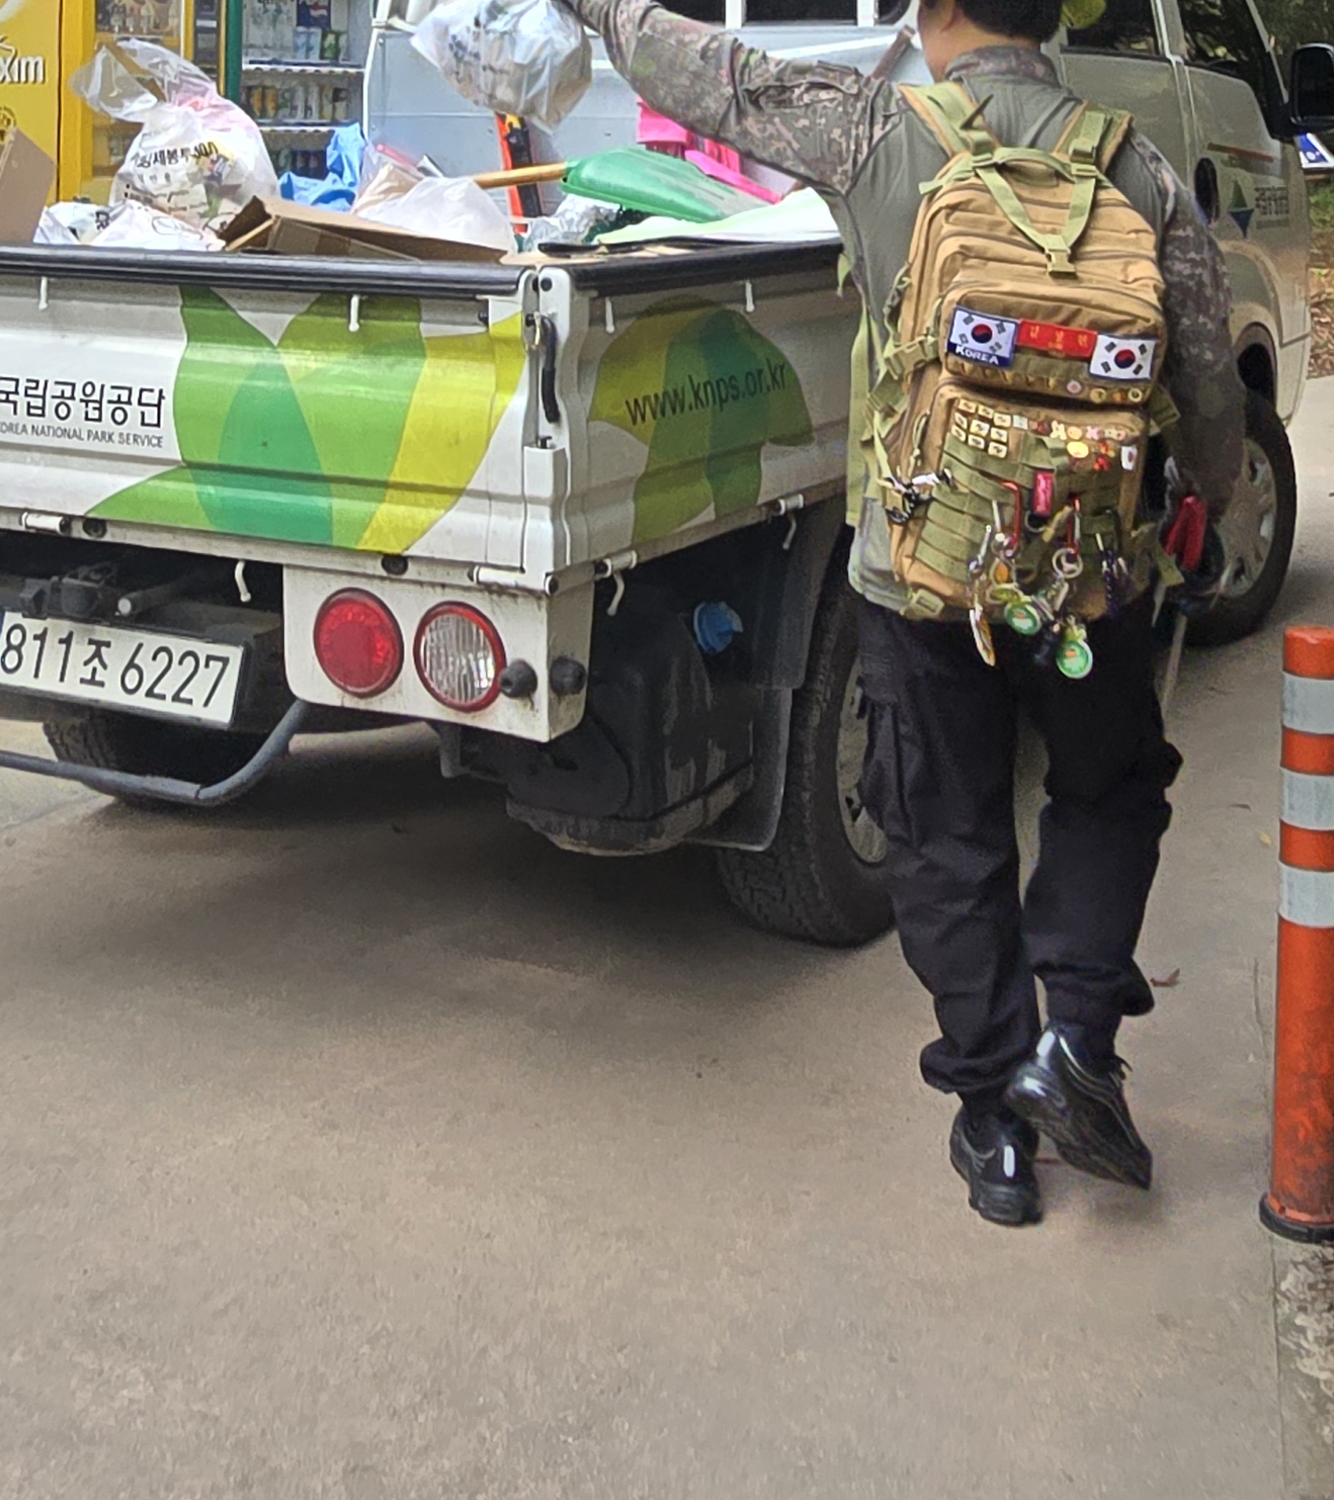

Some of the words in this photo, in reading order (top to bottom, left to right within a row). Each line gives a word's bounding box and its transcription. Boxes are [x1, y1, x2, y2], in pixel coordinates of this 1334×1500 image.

[955, 345, 999, 365] KOREA
[625, 357, 787, 426] www.knps.or.kr
[31, 425, 84, 442] NATIONAL
[86, 430, 115, 444] PARK
[118, 433, 164, 448] SERVICE
[0, 623, 112, 688] 811조
[120, 642, 230, 708] 6227
